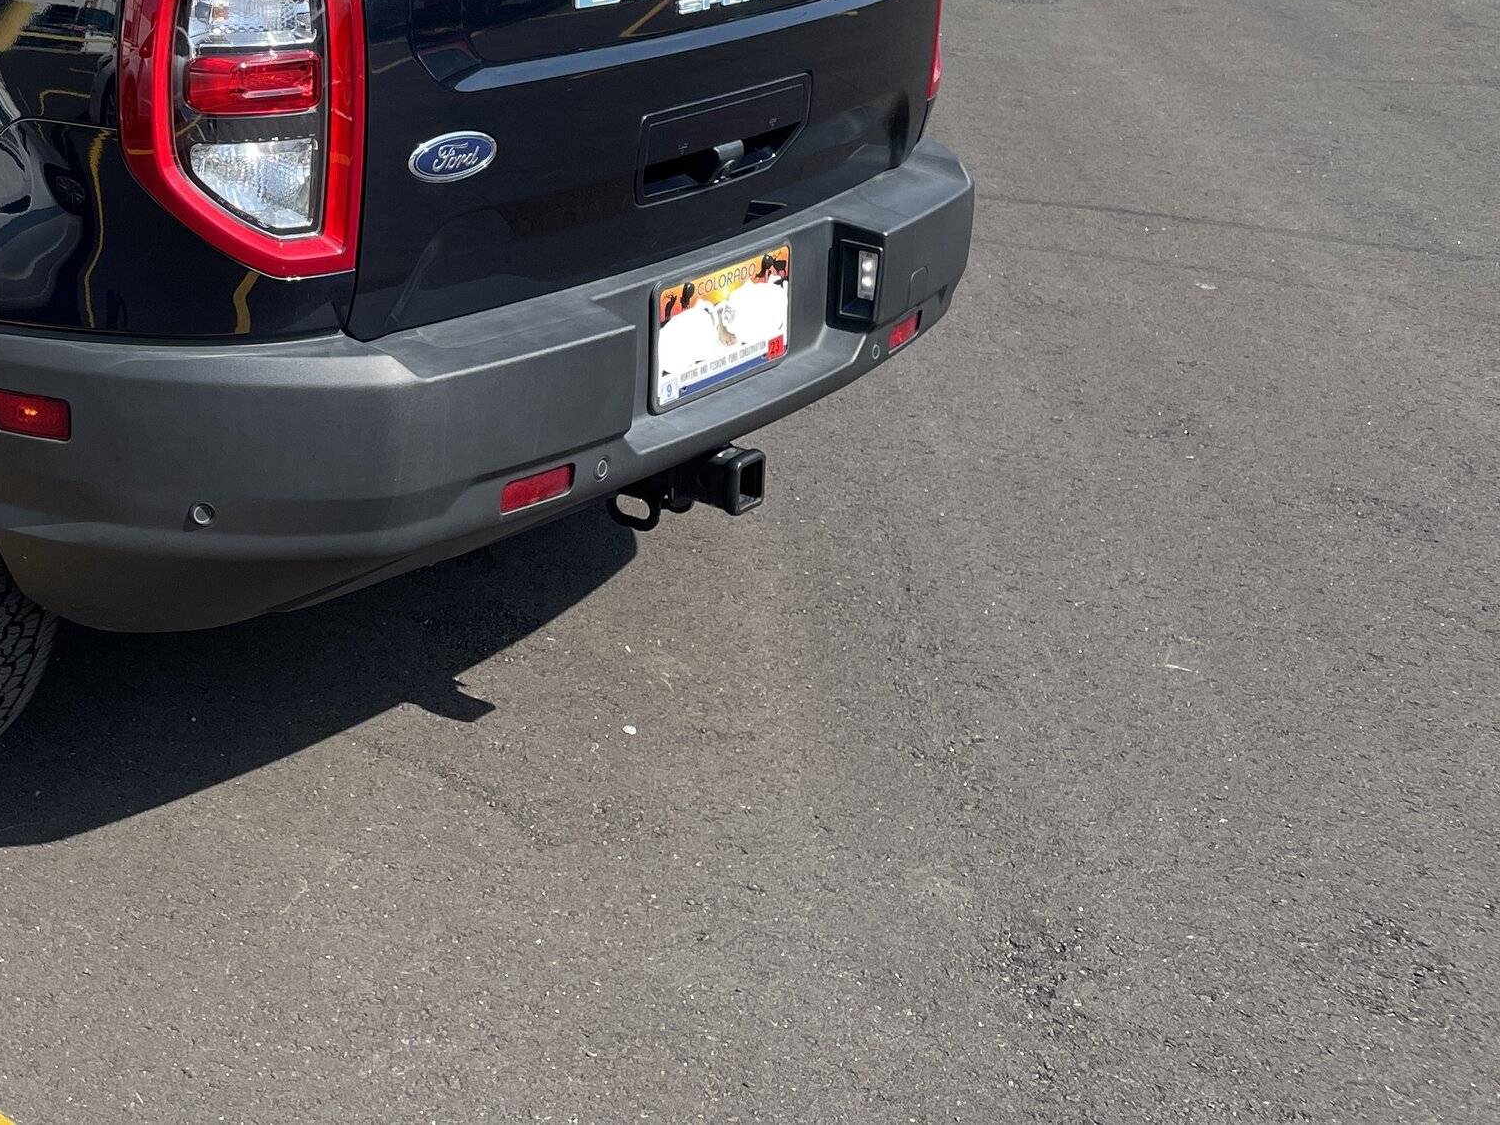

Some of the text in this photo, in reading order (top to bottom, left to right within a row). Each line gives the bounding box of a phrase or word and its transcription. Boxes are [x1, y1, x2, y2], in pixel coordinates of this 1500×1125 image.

[432, 142, 480, 172] Ford
[697, 263, 756, 296] COLORADO
[769, 339, 780, 354] 23
